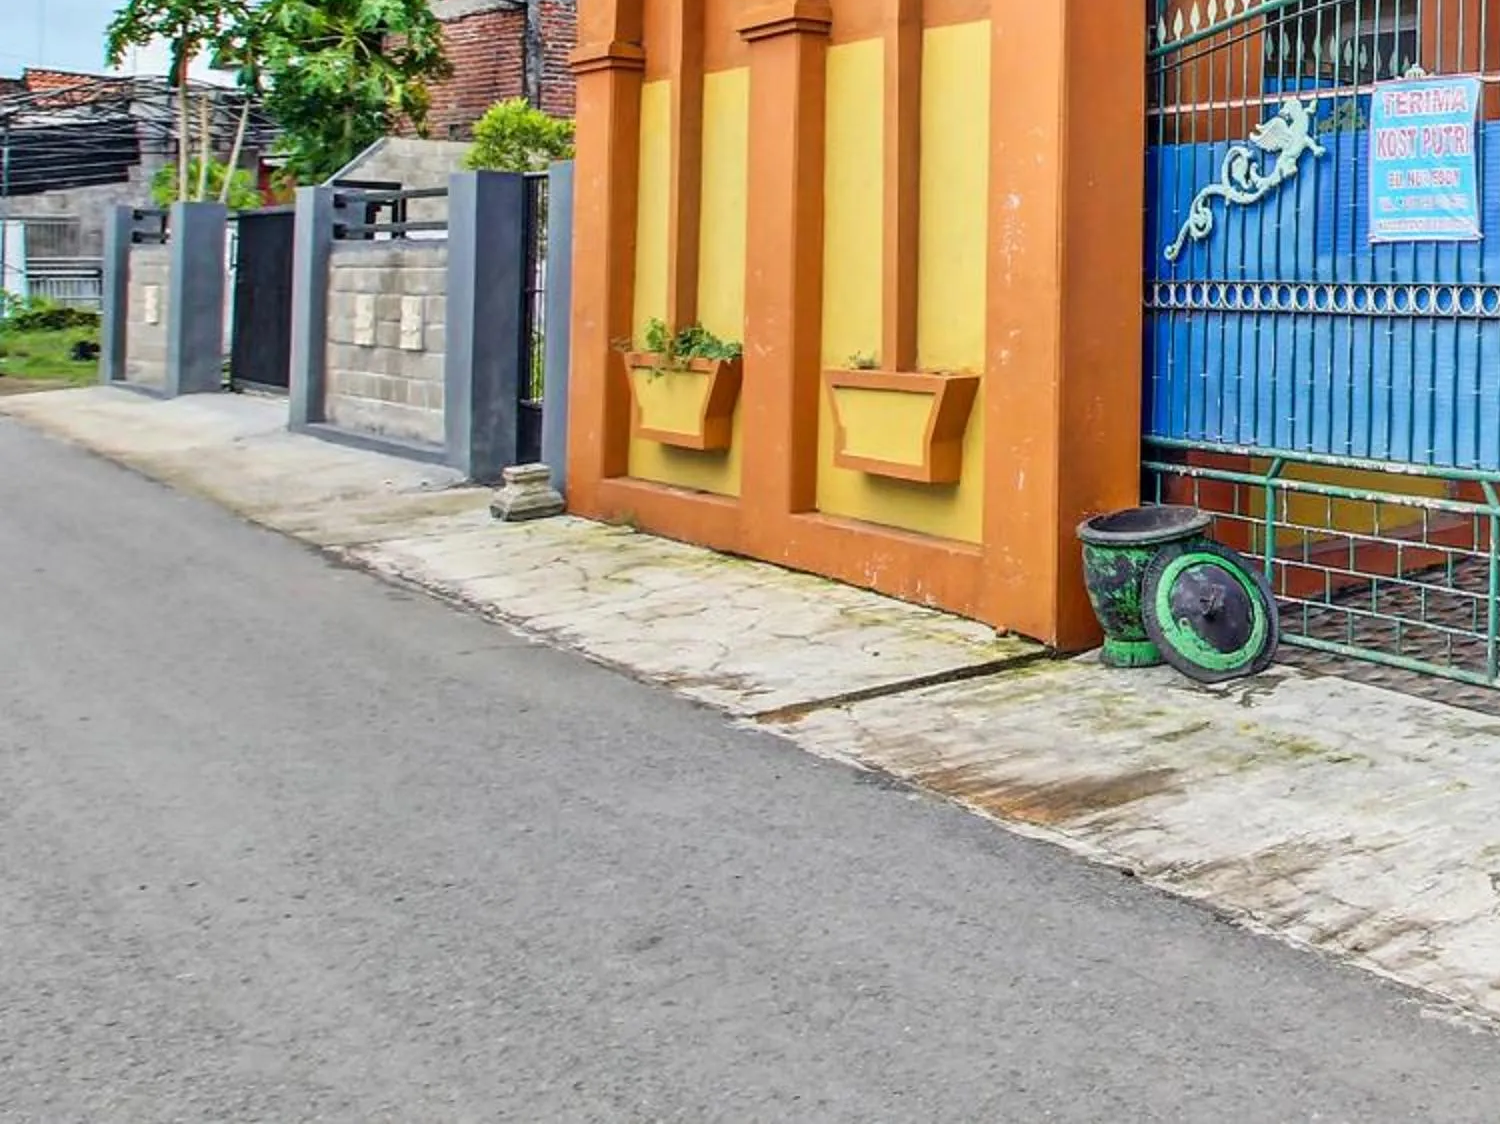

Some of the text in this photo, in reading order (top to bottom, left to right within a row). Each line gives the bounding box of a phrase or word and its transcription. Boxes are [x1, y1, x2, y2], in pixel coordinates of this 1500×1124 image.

[1383, 87, 1467, 115] TERIMA
[1376, 125, 1469, 158] KOST PUTRI
